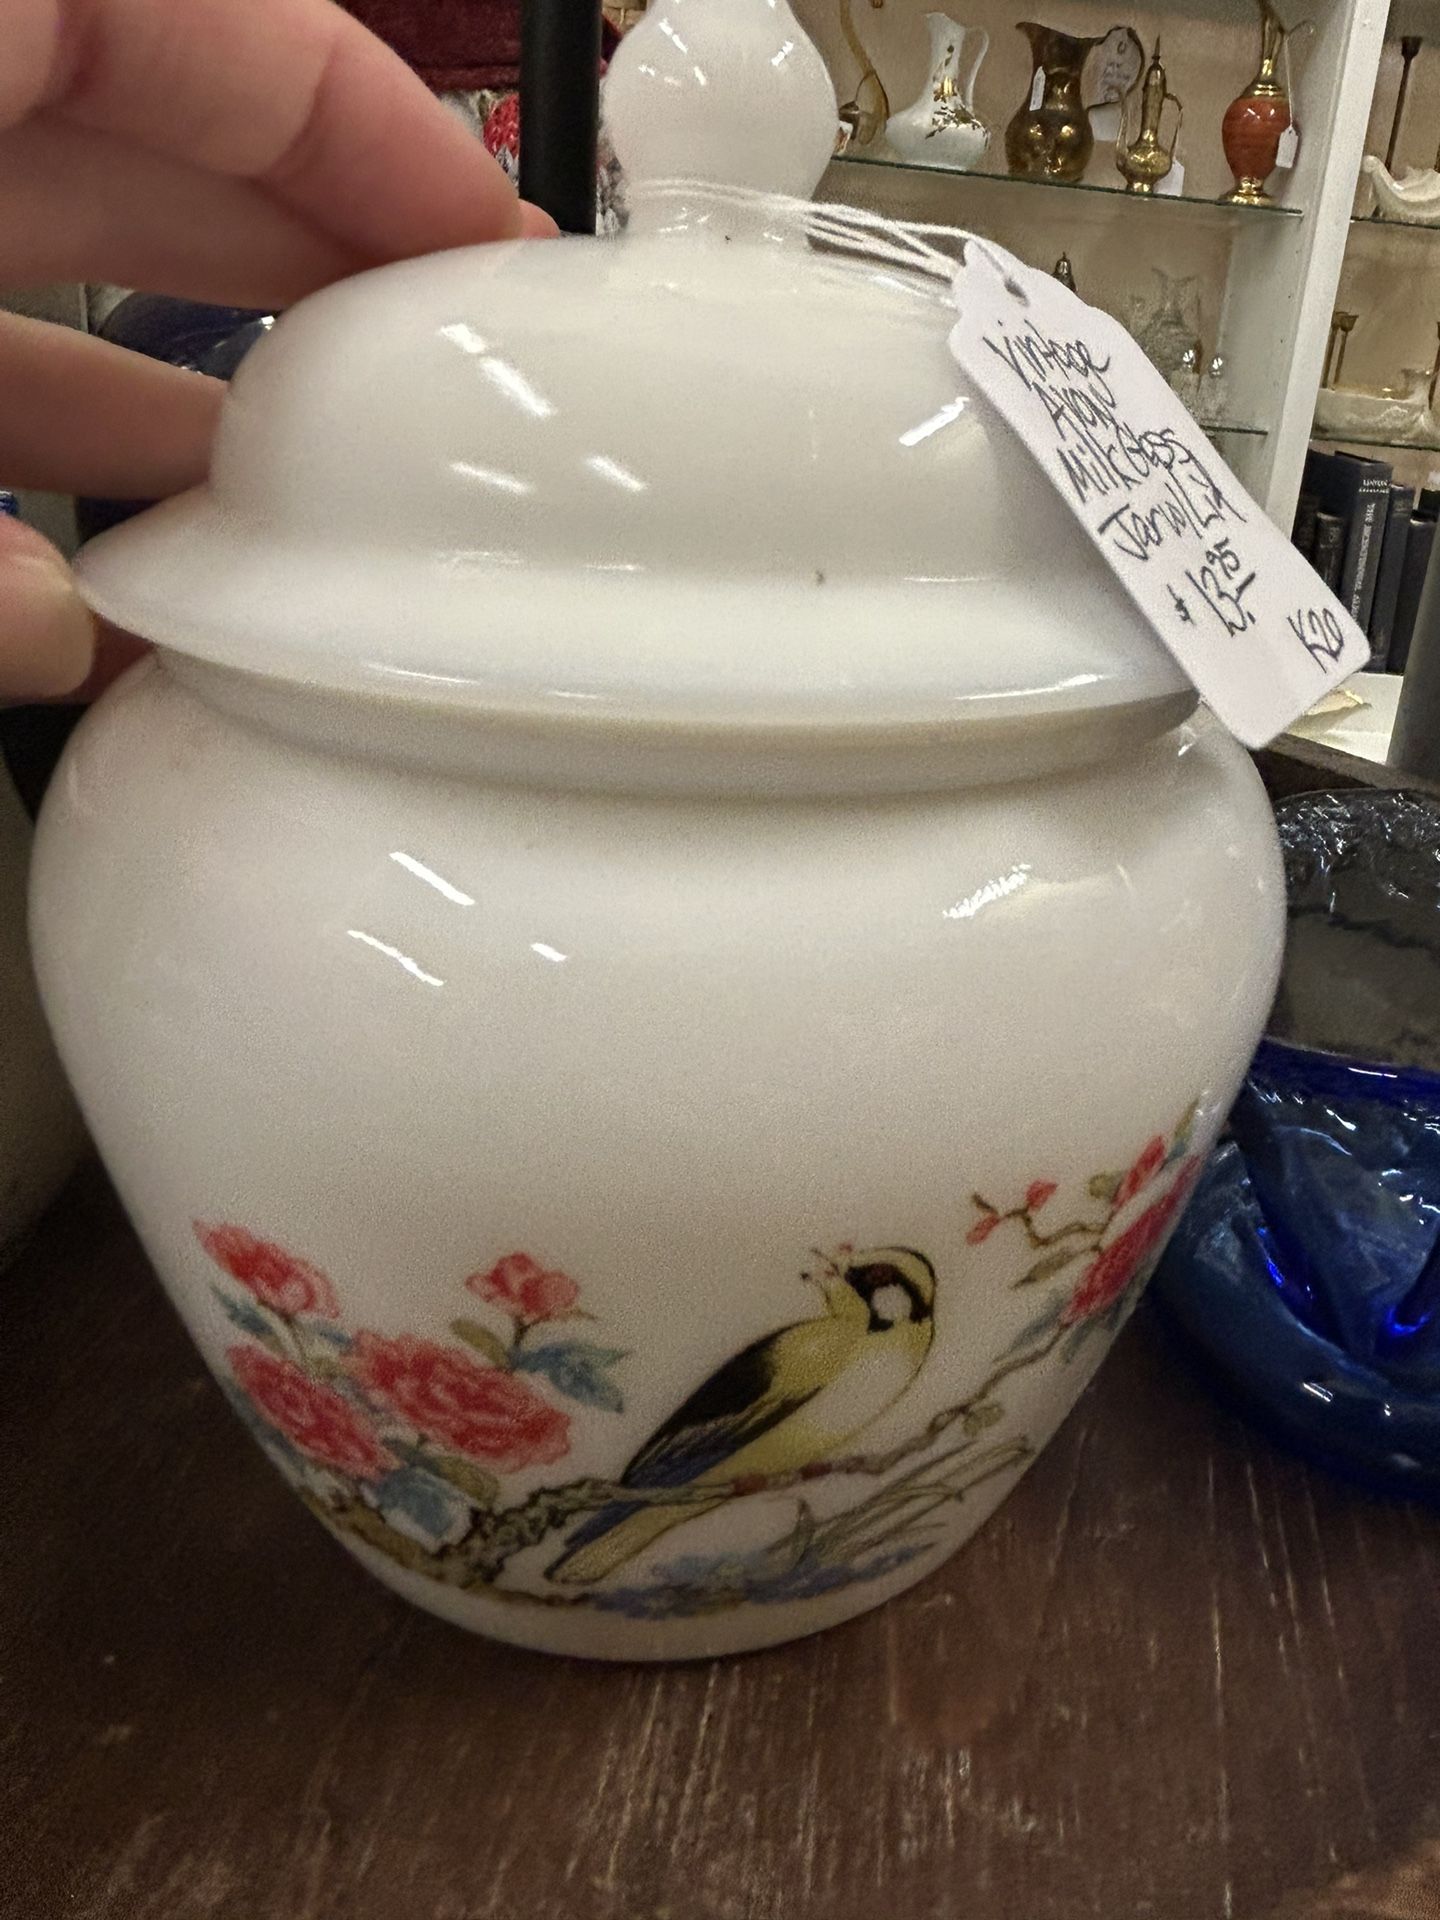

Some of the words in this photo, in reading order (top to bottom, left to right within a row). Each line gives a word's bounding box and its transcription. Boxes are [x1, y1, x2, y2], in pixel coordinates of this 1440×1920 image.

[983, 318, 1116, 408] Vintage
[1057, 430, 1141, 503] Milk
[1114, 421, 1191, 478] Glass
[1287, 608, 1345, 674] K20
